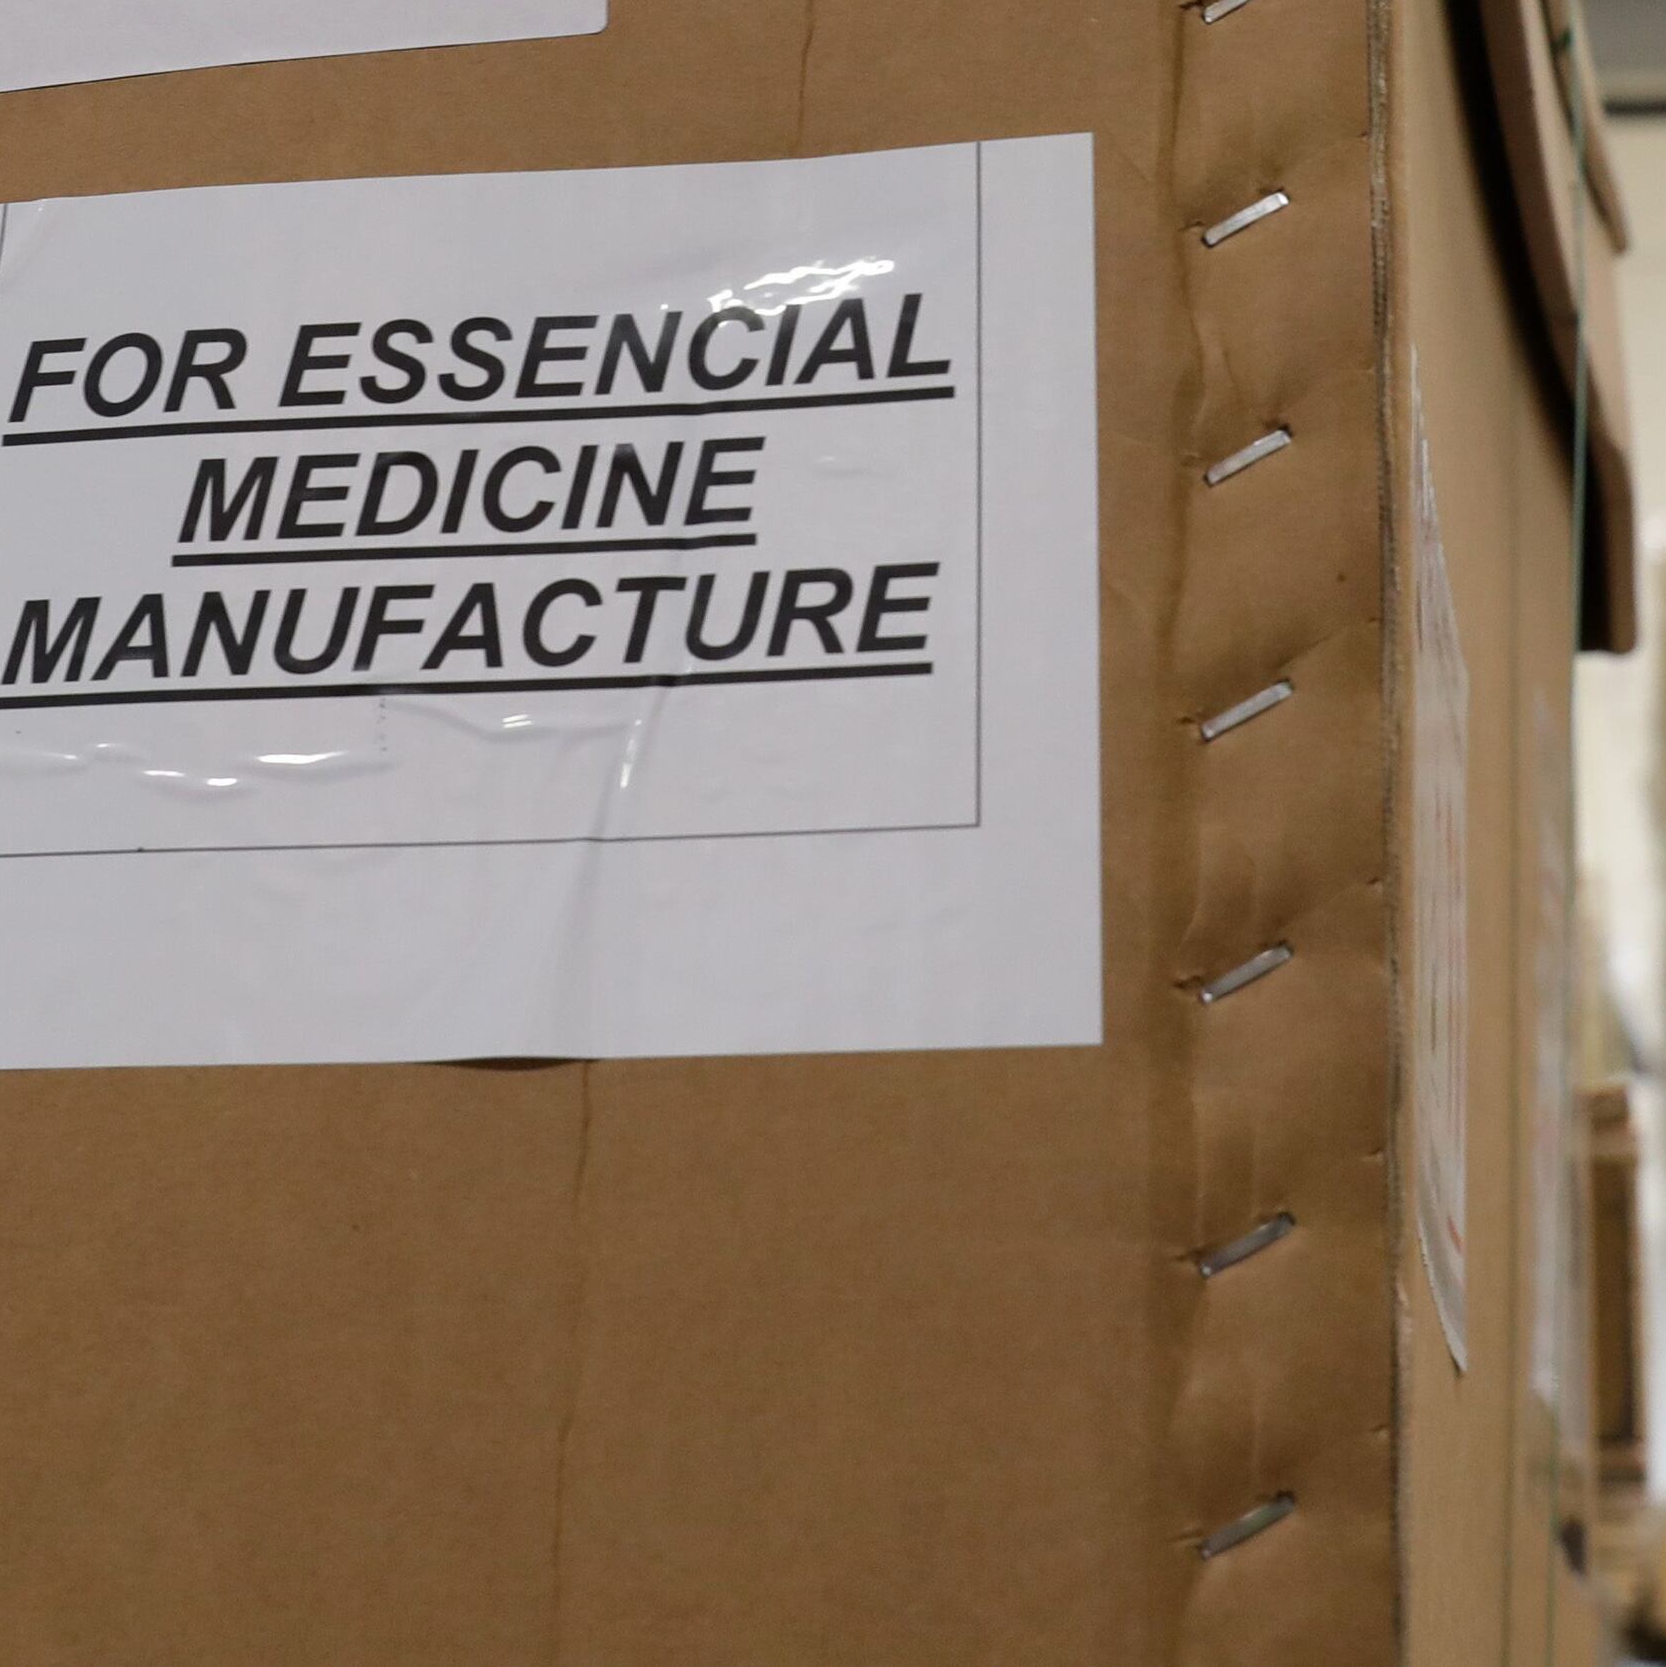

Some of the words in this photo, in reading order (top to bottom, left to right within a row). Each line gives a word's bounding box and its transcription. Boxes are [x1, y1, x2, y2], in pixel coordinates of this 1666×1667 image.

[7, 327, 249, 424] FOR
[277, 291, 952, 408] ESSENCIAL
[177, 435, 767, 544] MEDICINE
[0, 561, 941, 686] MANUFACTURE
